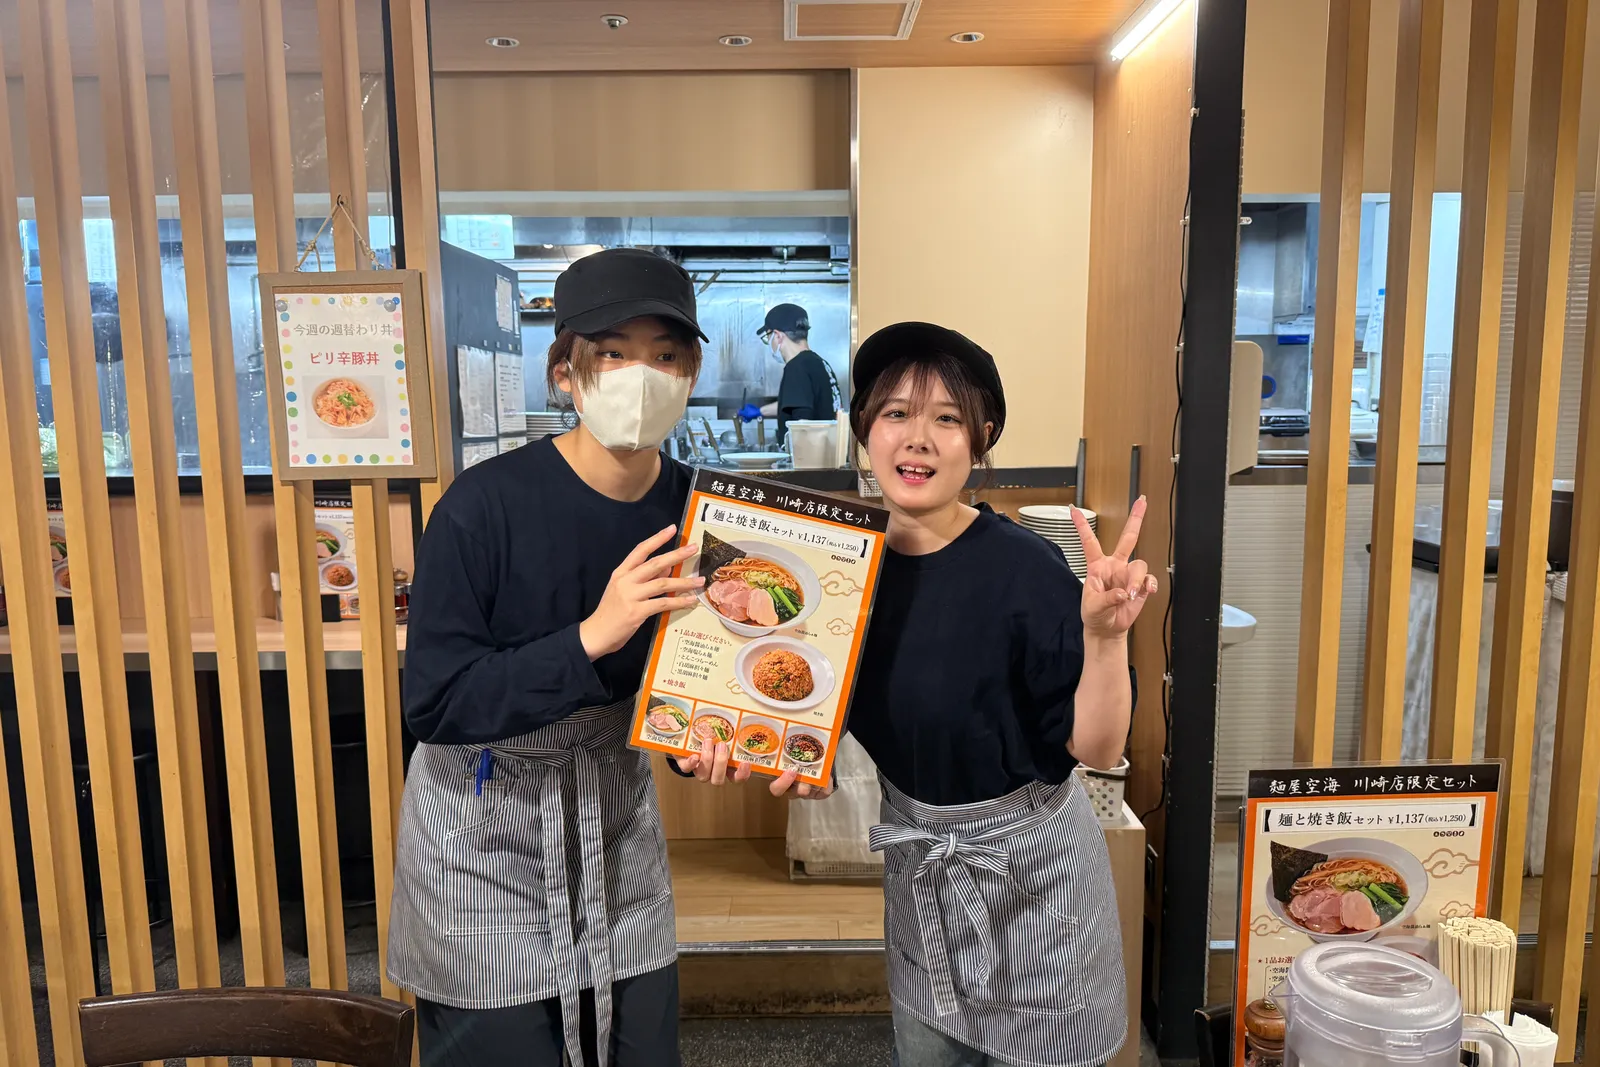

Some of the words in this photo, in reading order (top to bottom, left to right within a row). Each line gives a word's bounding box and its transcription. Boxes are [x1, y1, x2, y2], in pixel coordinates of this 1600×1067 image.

[294, 323, 393, 336] 今週の週替わり丼
[310, 351, 380, 365] ピリ辛豚丼
[710, 480, 767, 503] 麺屋空海
[776, 495, 871, 525] 川崎店限定セット
[1269, 776, 1341, 795] 麺屋空海
[1354, 774, 1477, 793] 川崎店限定セット
